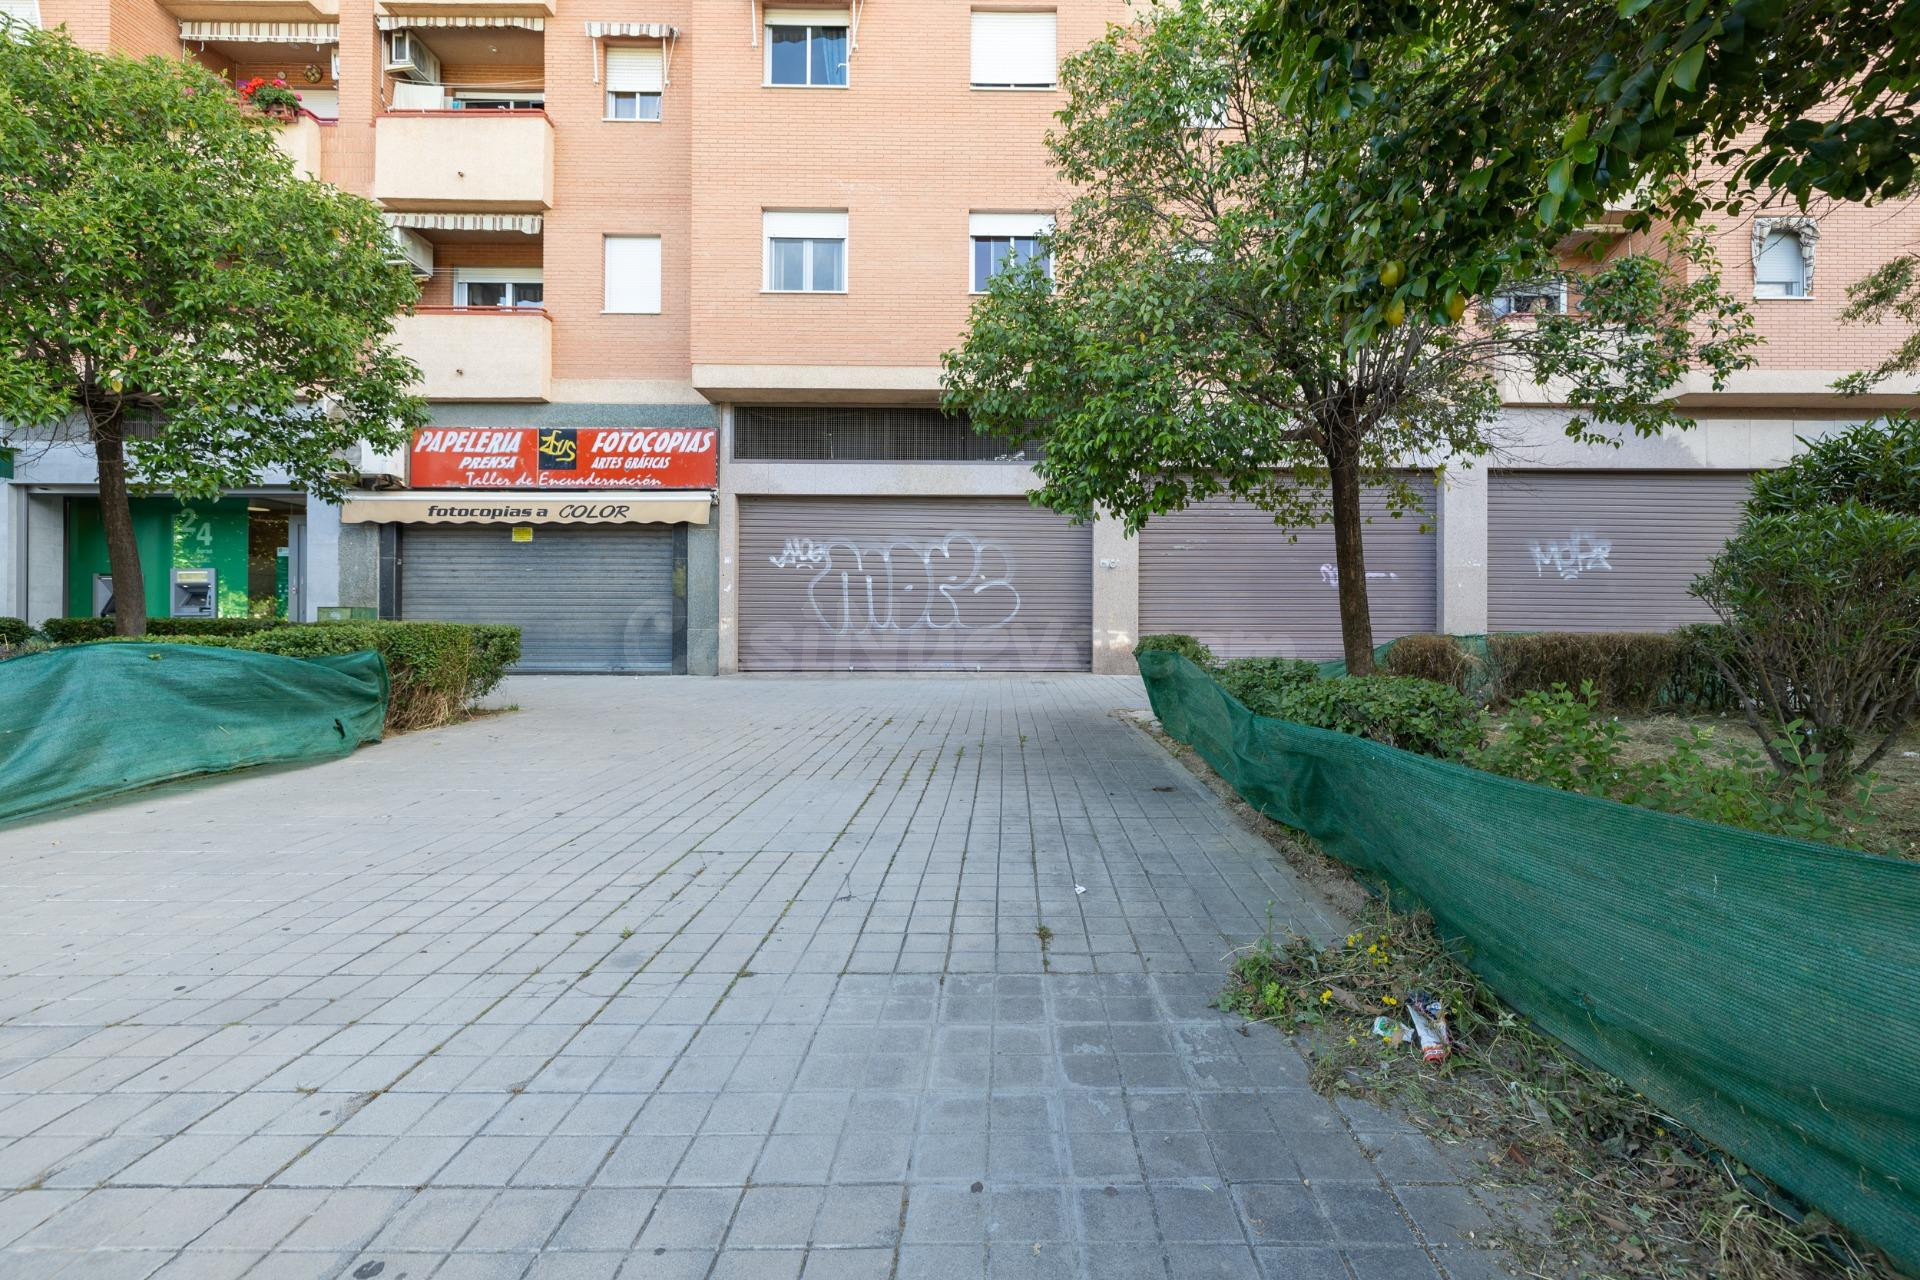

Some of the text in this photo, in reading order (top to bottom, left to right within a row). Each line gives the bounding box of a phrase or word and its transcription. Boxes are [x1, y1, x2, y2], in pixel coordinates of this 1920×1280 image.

[414, 431, 523, 454] PAPELERIA
[591, 431, 714, 454] FOTOCOPIAS
[458, 456, 518, 470] PRENSA
[591, 454, 671, 470] ARTES GRÁFICAS
[466, 471, 662, 487] Taller de Encuadernación
[427, 504, 630, 520] fotocopias a COLOR
